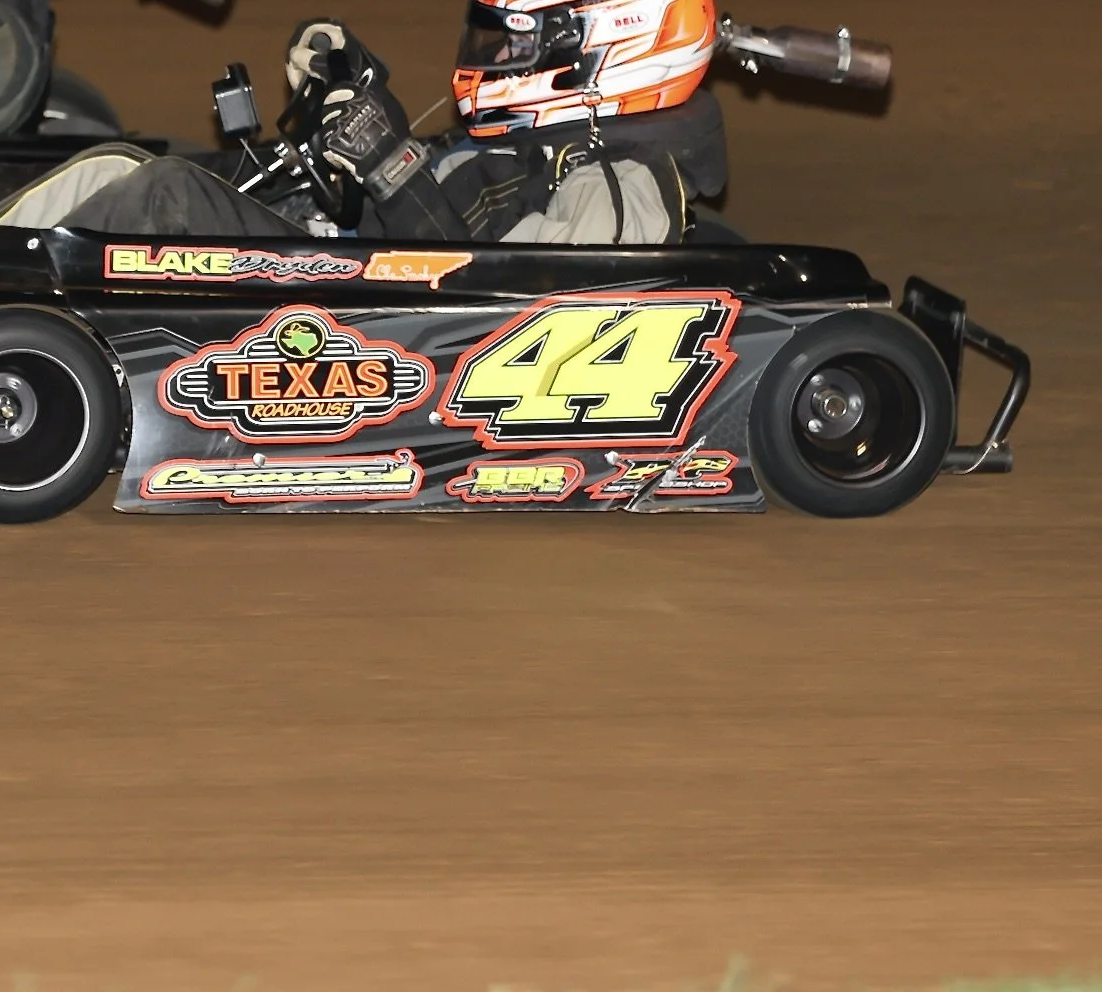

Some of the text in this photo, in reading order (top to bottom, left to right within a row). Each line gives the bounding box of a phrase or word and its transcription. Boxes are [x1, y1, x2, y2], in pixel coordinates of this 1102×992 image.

[614, 14, 644, 27] BELL
[112, 250, 233, 273] BLAKE
[460, 307, 706, 421] 44
[216, 360, 388, 400] TEXAS
[251, 402, 354, 418] ROADHOUSE
